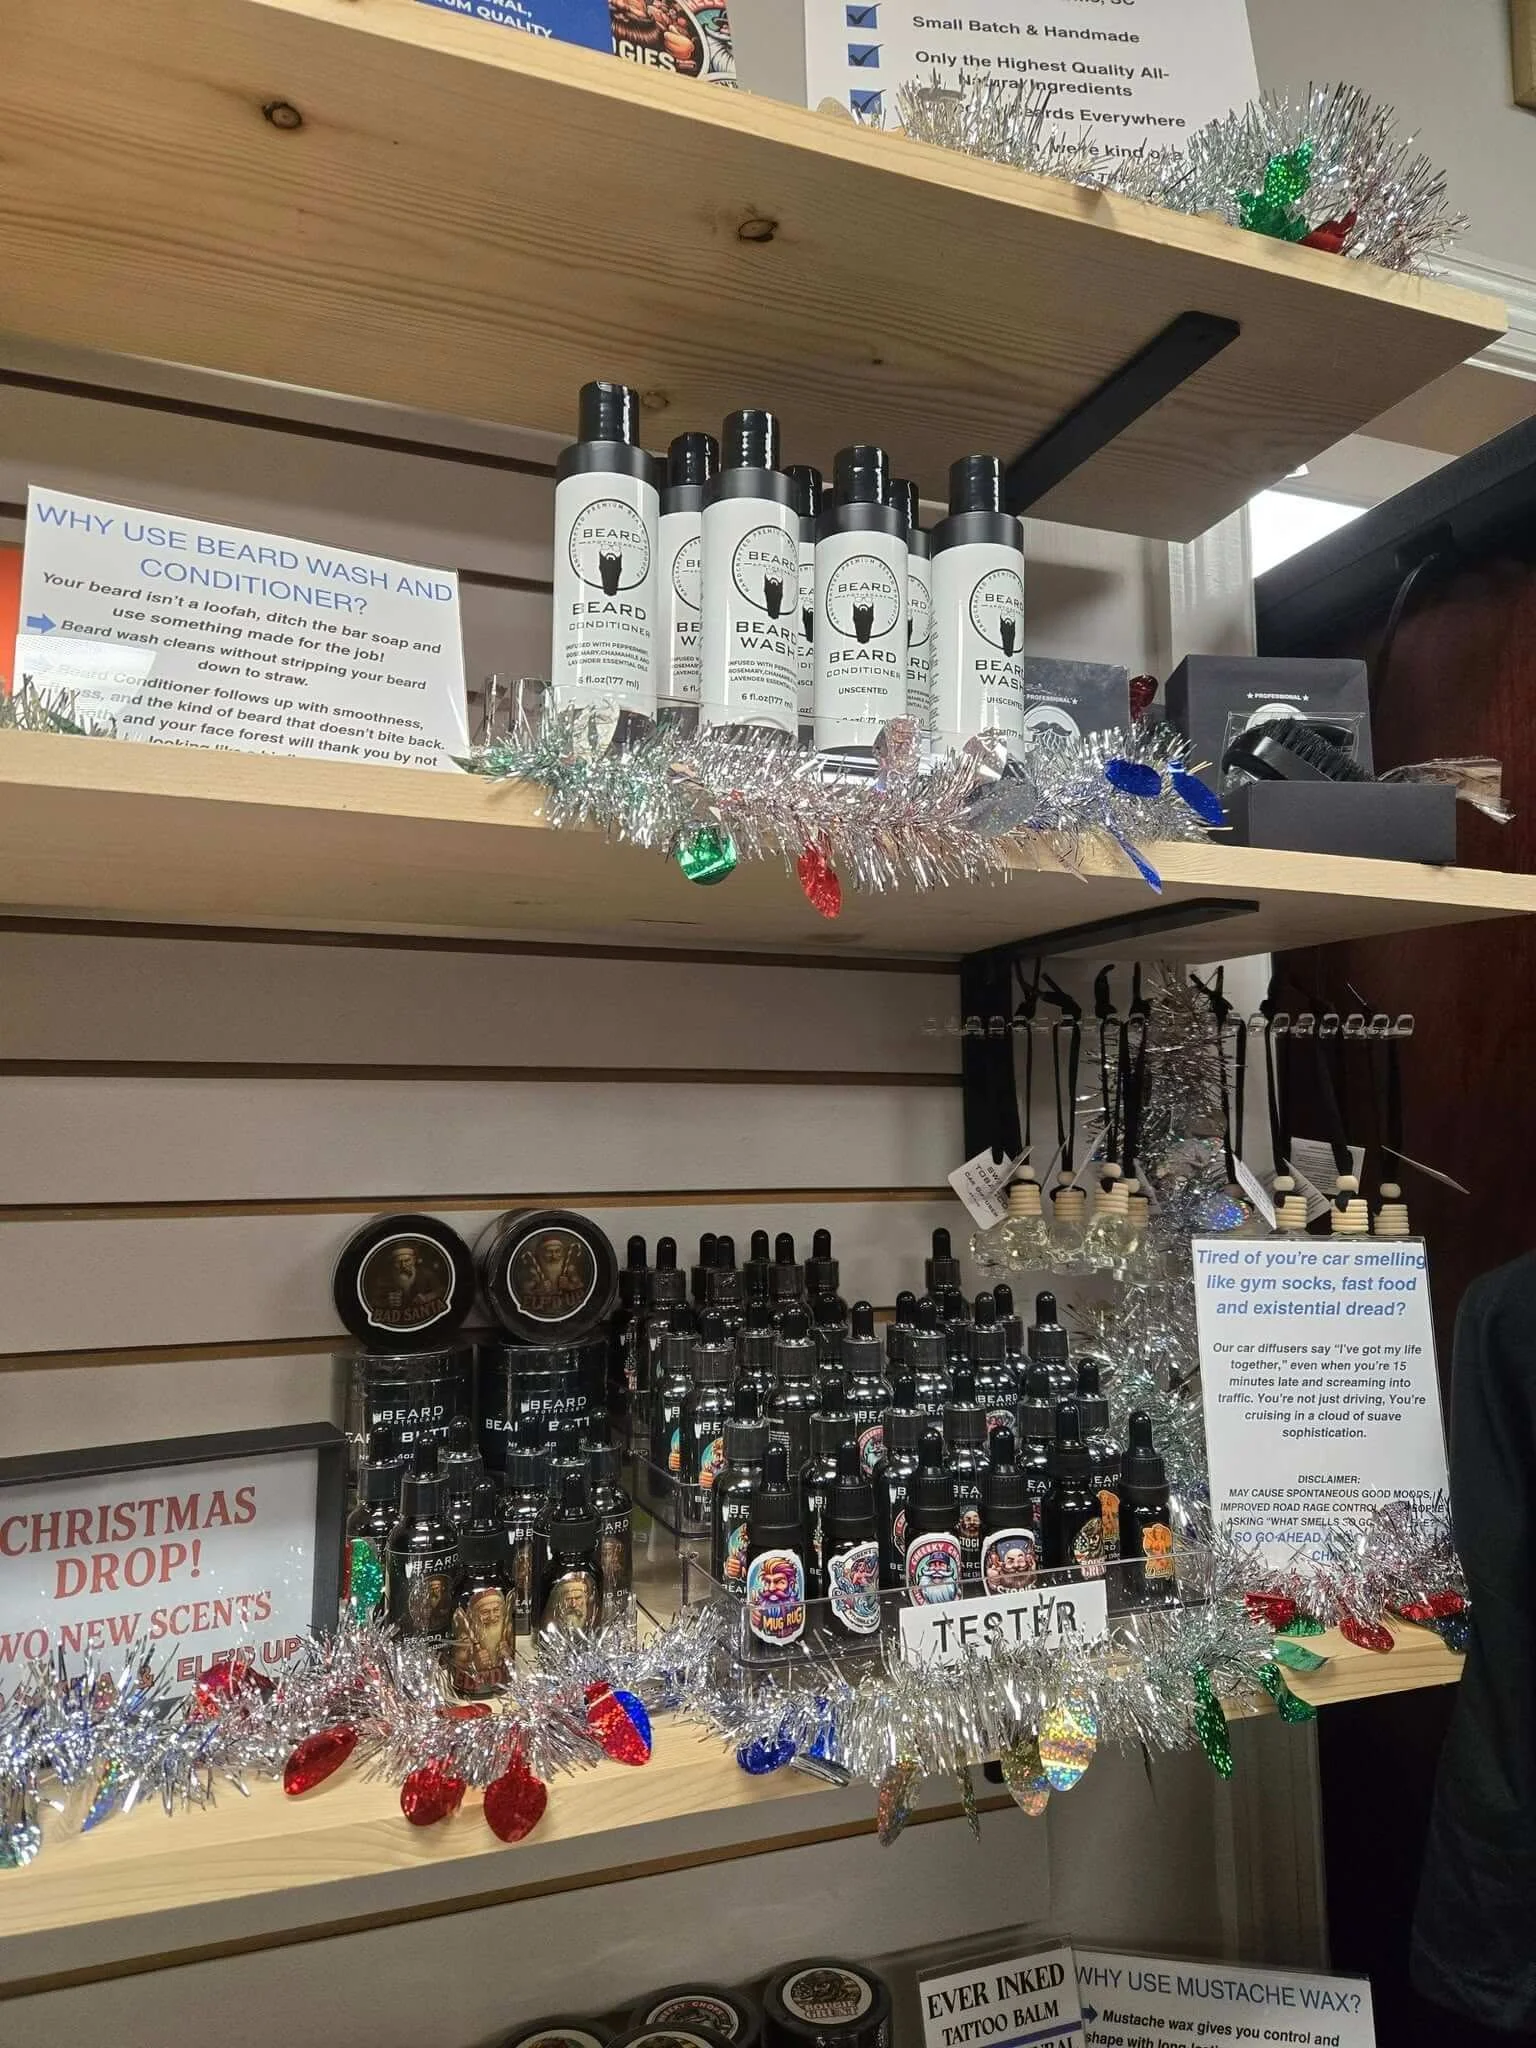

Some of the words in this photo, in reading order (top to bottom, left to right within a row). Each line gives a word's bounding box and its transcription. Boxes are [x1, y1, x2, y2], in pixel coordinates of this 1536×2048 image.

[476, 5, 553, 39] QUALITY
[912, 16, 962, 31] Small
[969, 20, 1020, 34] Batch
[1026, 25, 1039, 36] &
[1044, 26, 1141, 43] Handmade
[916, 51, 957, 67] Only
[963, 55, 991, 67] the
[997, 57, 1067, 72] Highest
[1072, 61, 1134, 79] Quality
[1141, 67, 1170, 80] All-
[1032, 80, 1133, 97] Ingredients
[1080, 109, 1186, 127] Everywhere
[1105, 145, 1144, 158] kind
[583, 528, 641, 543] BEARD
[36, 503, 115, 535] WHY
[124, 522, 188, 551] USE
[196, 535, 299, 570] BEARD
[305, 556, 388, 591] WASH
[396, 577, 453, 602] AND
[140, 558, 368, 615] CONDITIONER?
[838, 582, 892, 594] BEARD
[43, 572, 86, 590] Your
[88, 581, 143, 600] beard
[147, 591, 184, 607] isn't
[188, 599, 199, 609] a
[204, 601, 261, 622] loofah,
[266, 612, 308, 628] ditch
[313, 620, 338, 634] the
[342, 627, 370, 640] bar
[372, 634, 410, 650] soap
[413, 642, 442, 654] and
[572, 601, 647, 621] BEARD
[113, 608, 146, 622] use
[150, 616, 243, 641] something
[247, 628, 295, 646] made
[298, 637, 322, 651] for
[325, 643, 352, 656] the
[354, 647, 386, 664] job!
[568, 620, 651, 639] CONDITIONER
[61, 619, 112, 638] Beard
[117, 630, 159, 645] wash
[163, 637, 216, 655] cleans
[220, 646, 277, 664] without
[280, 657, 348, 679] stripping
[351, 668, 385, 684] your
[387, 676, 427, 691] beard
[829, 649, 897, 664] BEARD
[197, 660, 242, 676] down
[245, 665, 262, 678] to
[265, 668, 309, 688] straw.
[826, 666, 902, 680] CONDITIONER
[838, 686, 889, 698] UNSCENTED
[213, 688, 269, 705] follows
[274, 697, 293, 713] up
[298, 701, 328, 714] with
[333, 706, 424, 731] smoothness,
[146, 696, 173, 709] the
[177, 700, 212, 715] kind
[216, 707, 233, 719] of
[237, 708, 283, 726] beard
[286, 716, 315, 731] that
[319, 722, 374, 740] doesn't
[377, 730, 405, 744] bite
[408, 735, 445, 751] back.
[122, 713, 155, 727] and
[159, 719, 197, 735] your
[200, 723, 234, 738] face
[238, 727, 284, 745] forest
[288, 736, 314, 750] will
[318, 740, 359, 756] thank
[363, 748, 390, 760] you
[394, 751, 412, 766] by
[414, 754, 439, 768] not
[1197, 1249, 1241, 1265] Tired
[1244, 1250, 1263, 1265] of
[1265, 1252, 1318, 1268] you're
[1323, 1254, 1351, 1266] car
[1353, 1252, 1426, 1270] smelling
[1206, 1275, 1236, 1289] like
[1240, 1278, 1277, 1293] gym
[1281, 1276, 1336, 1292] socks,
[1341, 1276, 1374, 1291] fast
[1377, 1277, 1417, 1291] food
[1216, 1300, 1249, 1315] and
[1253, 1300, 1341, 1316] existential
[1345, 1302, 1407, 1316] dread?
[1212, 1342, 1235, 1354] Our
[1237, 1344, 1256, 1354] car
[1258, 1343, 1309, 1355] diffusers
[1310, 1346, 1332, 1357] say
[1362, 1346, 1382, 1357] got
[1384, 1347, 1403, 1358] my
[1404, 1345, 1423, 1355] life
[1321, 1361, 1352, 1371] when
[1354, 1362, 1391, 1373] you're
[1229, 1376, 1275, 1388] minutes
[1278, 1377, 1299, 1388] late
[1301, 1377, 1324, 1388] and
[1326, 1378, 1387, 1391] screaming
[1389, 1378, 1412, 1389] into
[530, 1396, 587, 1411] BEARD
[978, 1393, 1018, 1405] BEARD
[1218, 1393, 1254, 1404] traffic.
[1257, 1393, 1294, 1405] You're
[1297, 1395, 1317, 1405] not
[1318, 1394, 1341, 1407] just
[1342, 1394, 1386, 1408] driving,
[1389, 1394, 1427, 1406] You're
[382, 1405, 445, 1421] BEARD
[1244, 1410, 1292, 1423] cruising
[1294, 1411, 1308, 1421] in
[1318, 1411, 1351, 1422] cloud
[1353, 1411, 1366, 1422] of
[1367, 1412, 1403, 1422] suave
[1282, 1427, 1368, 1440] sophistication.
[1297, 1475, 1362, 1485] DISCLAIMER:
[1229, 1488, 1250, 1498] MAY
[1251, 1488, 1285, 1498] CAUSE
[1286, 1489, 1361, 1499] SPONTANEOUS
[1361, 1490, 1391, 1499] GOOD
[1220, 1502, 1271, 1512] IMPROVED
[1272, 1502, 1301, 1512] ROAD
[1303, 1503, 1332, 1512] RAGE
[0, 1486, 258, 1557] CHRISTMAS
[1300, 1518, 1340, 1528] SMELLS
[1234, 1532, 1254, 1543] SO
[1277, 1532, 1323, 1543] AHEAD
[53, 1539, 202, 1600] DROP!
[0, 1629, 50, 1664] WO
[58, 1613, 143, 1655] NEW
[149, 1591, 273, 1641] SCENTS
[762, 1614, 785, 1631] MUG
[786, 1606, 803, 1626] RUG
[931, 1601, 1078, 1653] TESTER
[262, 1636, 302, 1665] UP
[926, 1980, 990, 2020] EVER
[994, 1962, 1066, 2002] INKED
[1076, 1966, 1122, 1990] WHY
[1127, 1970, 1171, 1995] USE
[1176, 1975, 1297, 2008] MUSTACHE
[1298, 1985, 1362, 2015] WAX?
[941, 2012, 1009, 2048] TATTOO
[1012, 1998, 1061, 2028] BALM
[1102, 2008, 1166, 2030] Mustache
[1167, 2018, 1194, 2033] wax
[1196, 2021, 1233, 2039] gives
[1235, 2026, 1263, 2044] you
[1265, 2028, 1312, 2046] control
[1314, 2033, 1342, 2048] and
[1086, 2031, 1124, 2048] shape
